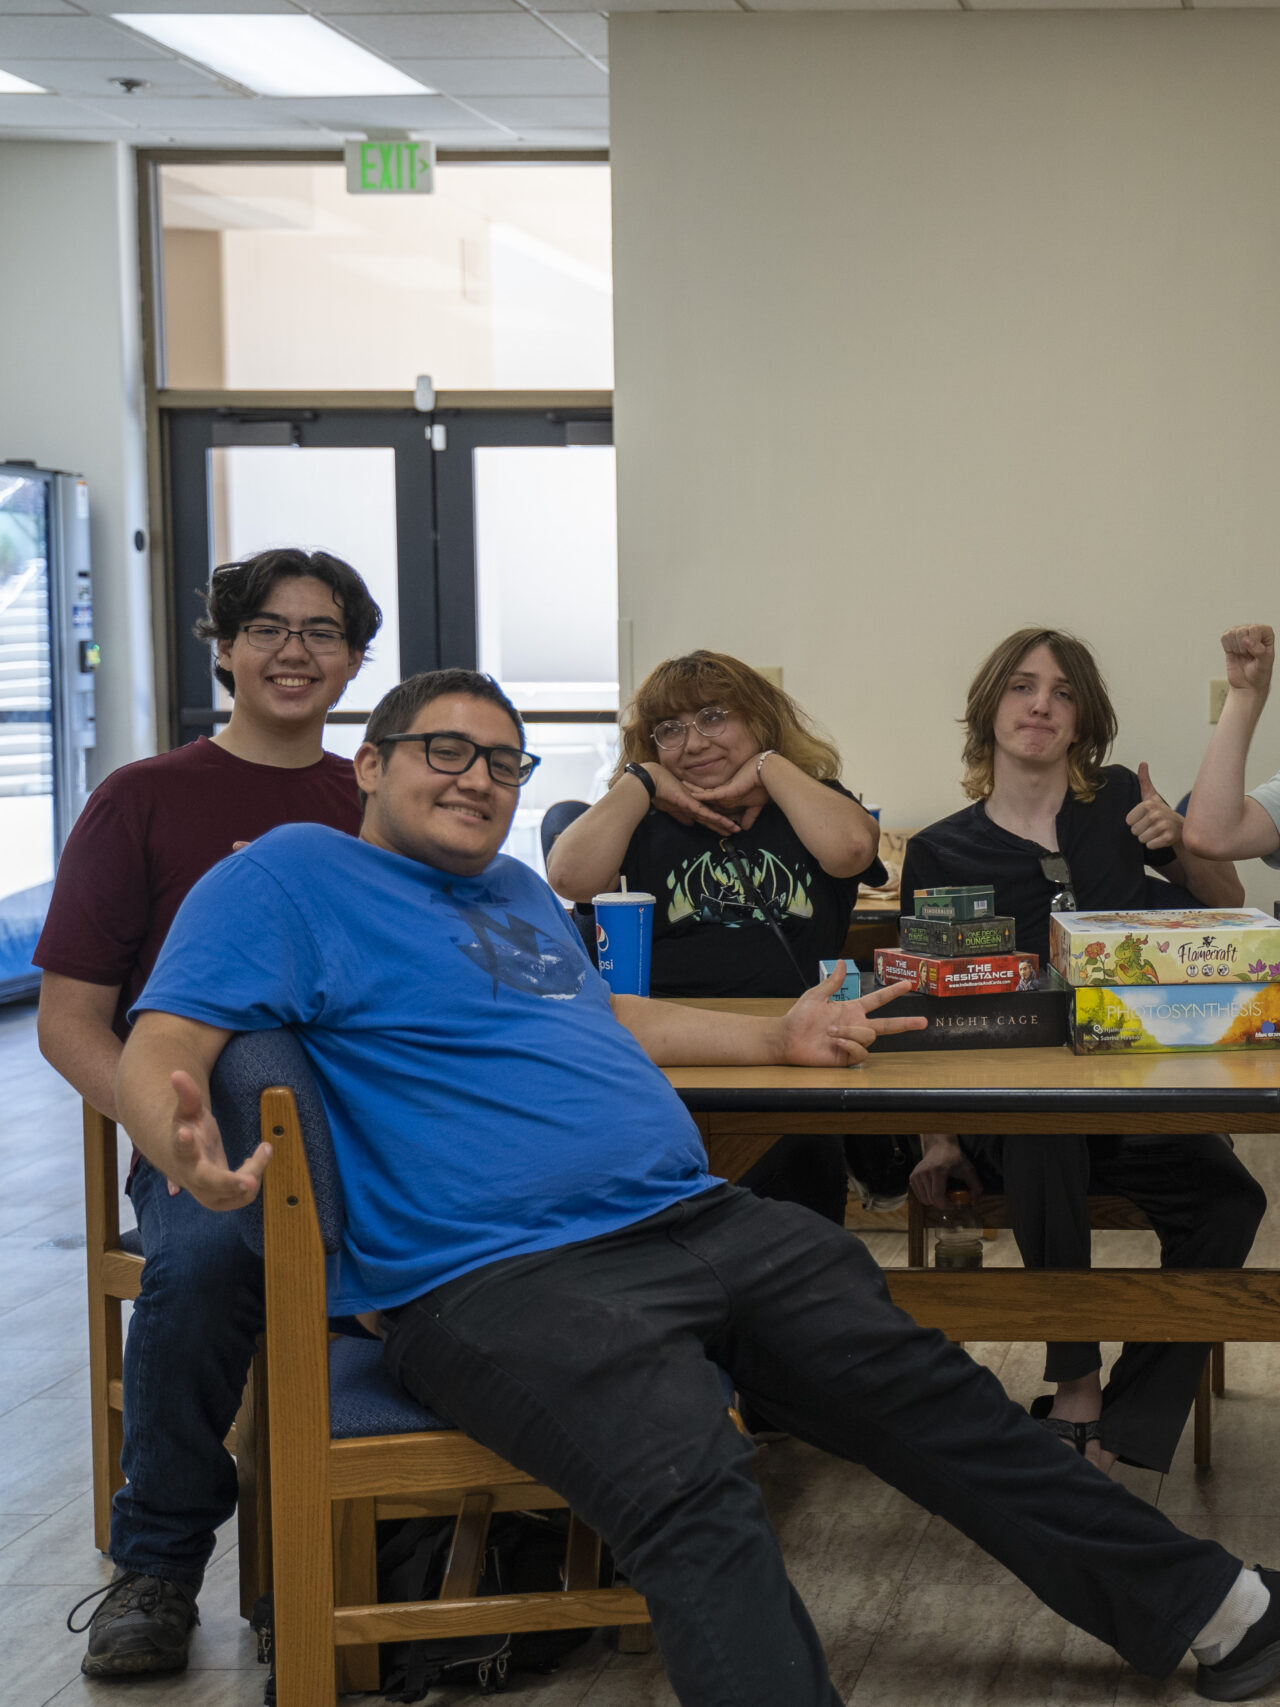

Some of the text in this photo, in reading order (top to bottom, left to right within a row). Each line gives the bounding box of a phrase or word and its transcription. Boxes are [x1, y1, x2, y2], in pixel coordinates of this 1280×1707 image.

[361, 143, 419, 190] EXIT
[981, 929, 999, 937] DECK
[1177, 941, 1238, 964] Flamecraft
[895, 960, 907, 969] THE
[967, 963, 992, 973] THE
[885, 966, 918, 978] RESISTANCE
[944, 970, 1014, 982] RESISTANCE
[1107, 1001, 1262, 1021] PHOTOSYNTHESIS
[935, 1015, 1038, 1027] NIGHT CAGE
